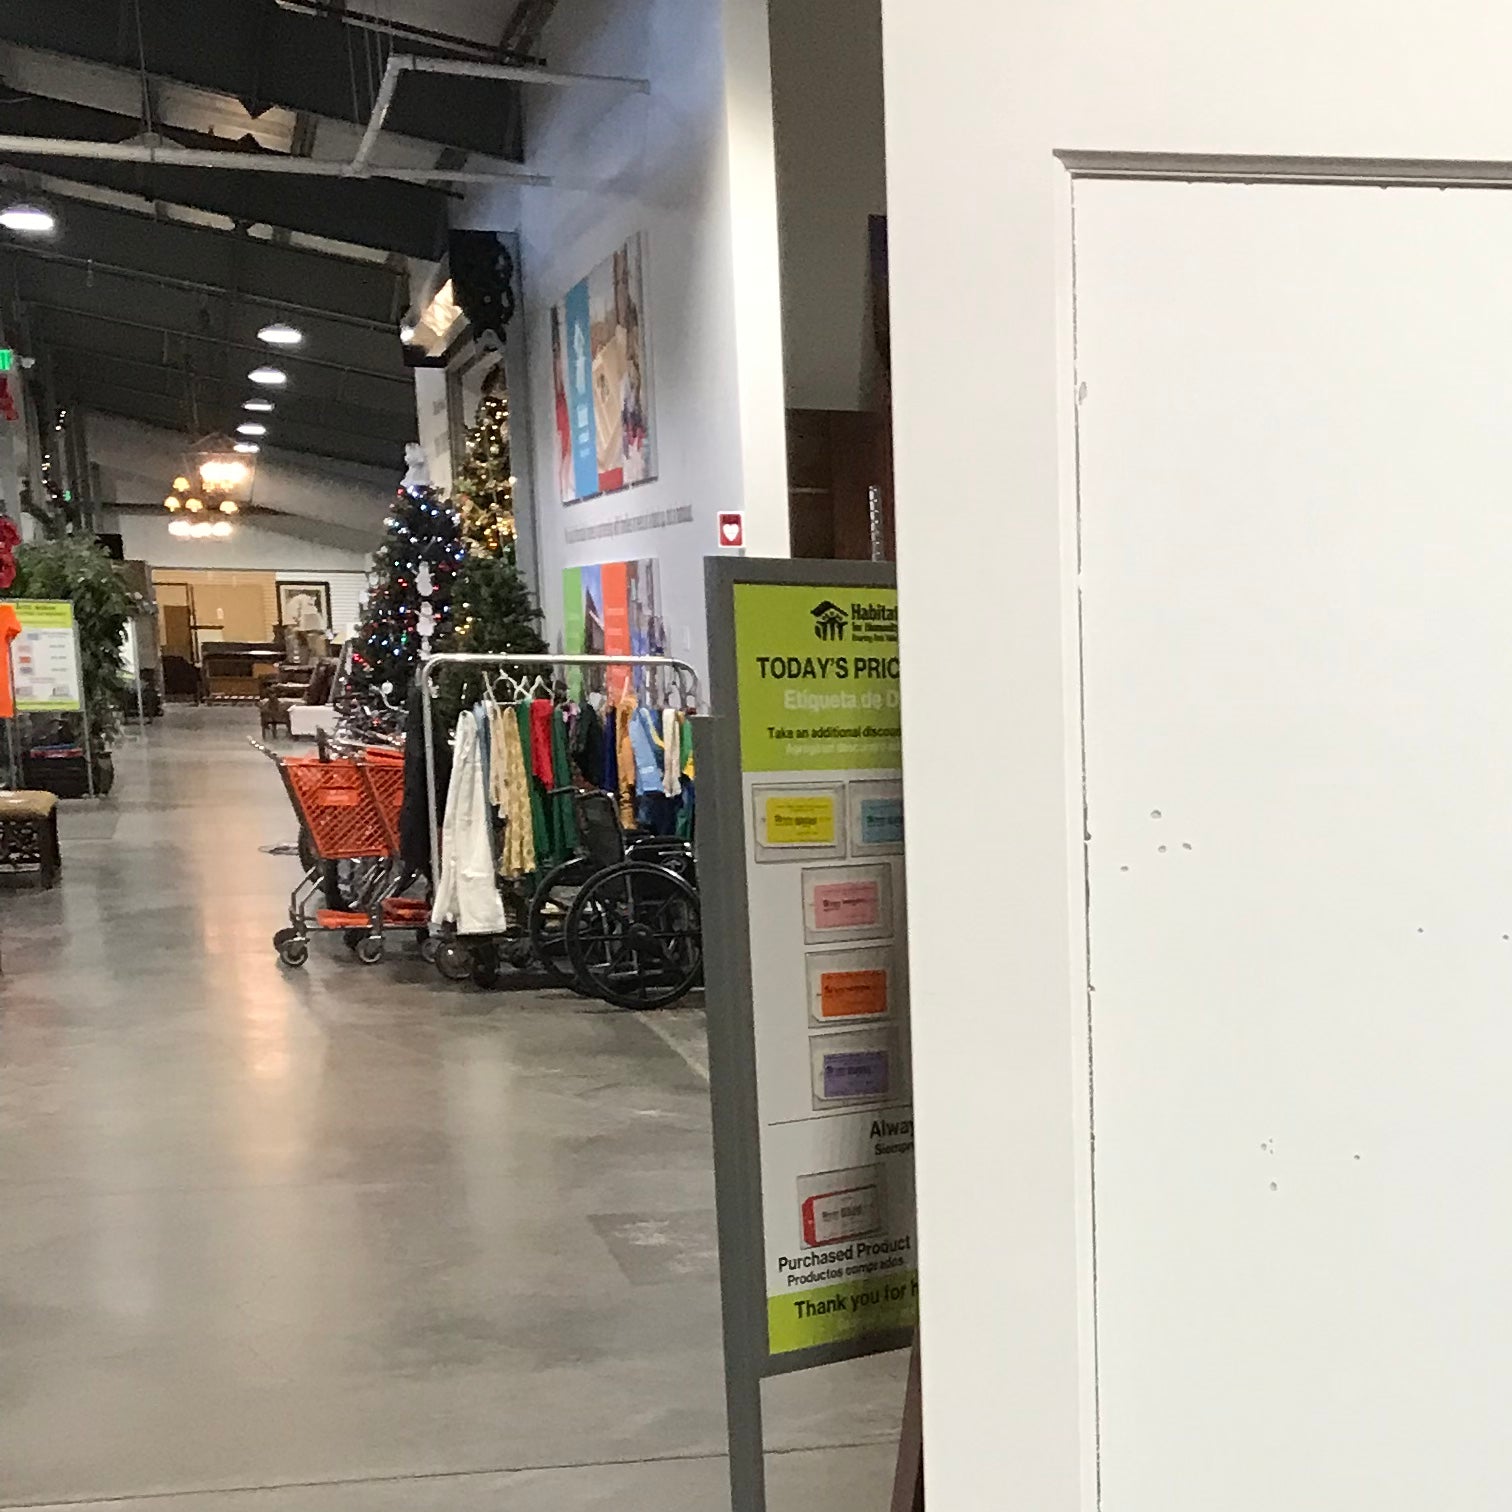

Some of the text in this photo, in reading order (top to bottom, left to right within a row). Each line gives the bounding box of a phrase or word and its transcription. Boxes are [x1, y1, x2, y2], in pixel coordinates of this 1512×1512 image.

[756, 657, 849, 679] TODAY'S
[784, 690, 857, 712] Etiqueta
[861, 690, 882, 710] de
[768, 727, 794, 739] Take
[796, 729, 809, 738] an
[811, 726, 861, 738] additional
[778, 1235, 911, 1273] Purchased Product
[787, 1267, 843, 1287] Productos
[794, 1294, 847, 1319] Thank
[850, 1291, 880, 1312] you
[884, 1284, 906, 1302] for
